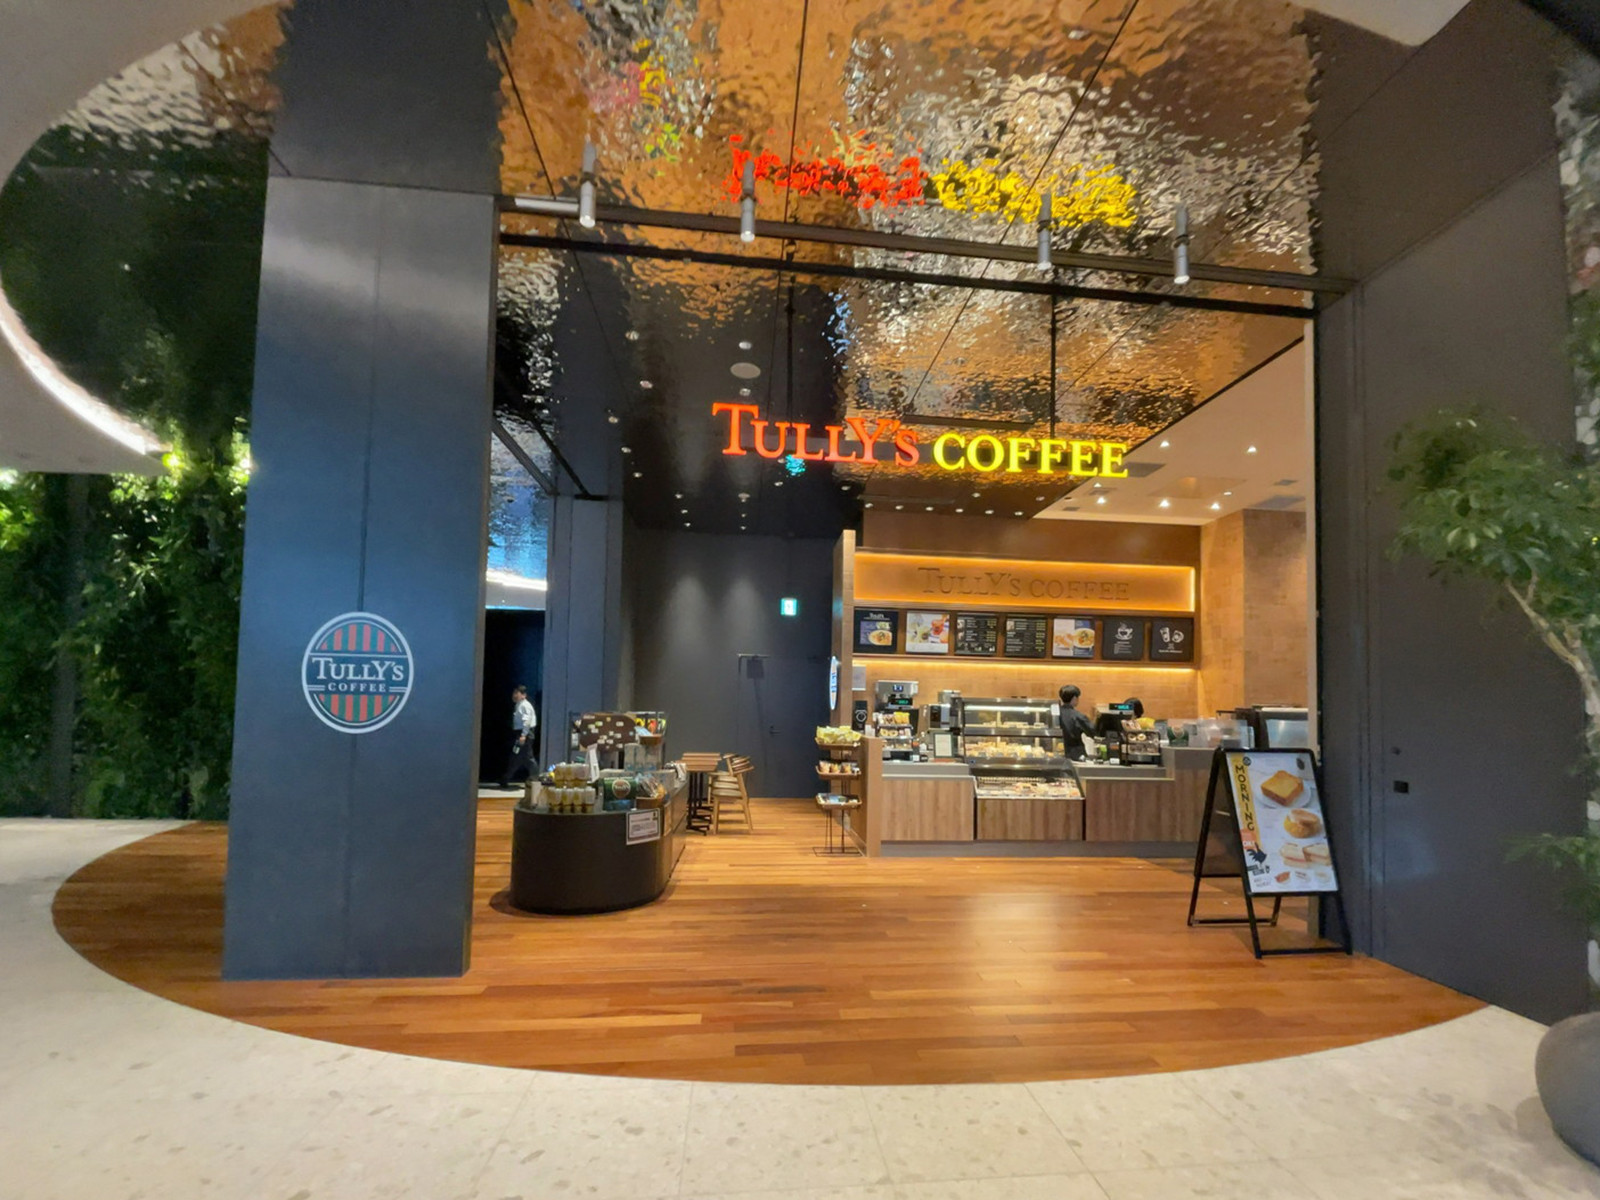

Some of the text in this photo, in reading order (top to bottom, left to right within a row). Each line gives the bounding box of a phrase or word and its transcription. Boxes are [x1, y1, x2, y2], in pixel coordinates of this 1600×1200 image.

[712, 402, 1129, 479] TULLY'S COFFEE
[918, 567, 1130, 601] TULLY'S COFFEE
[311, 657, 404, 681] TULLY'S
[328, 683, 386, 692] COFFEE
[1235, 766, 1254, 831] MORNING
